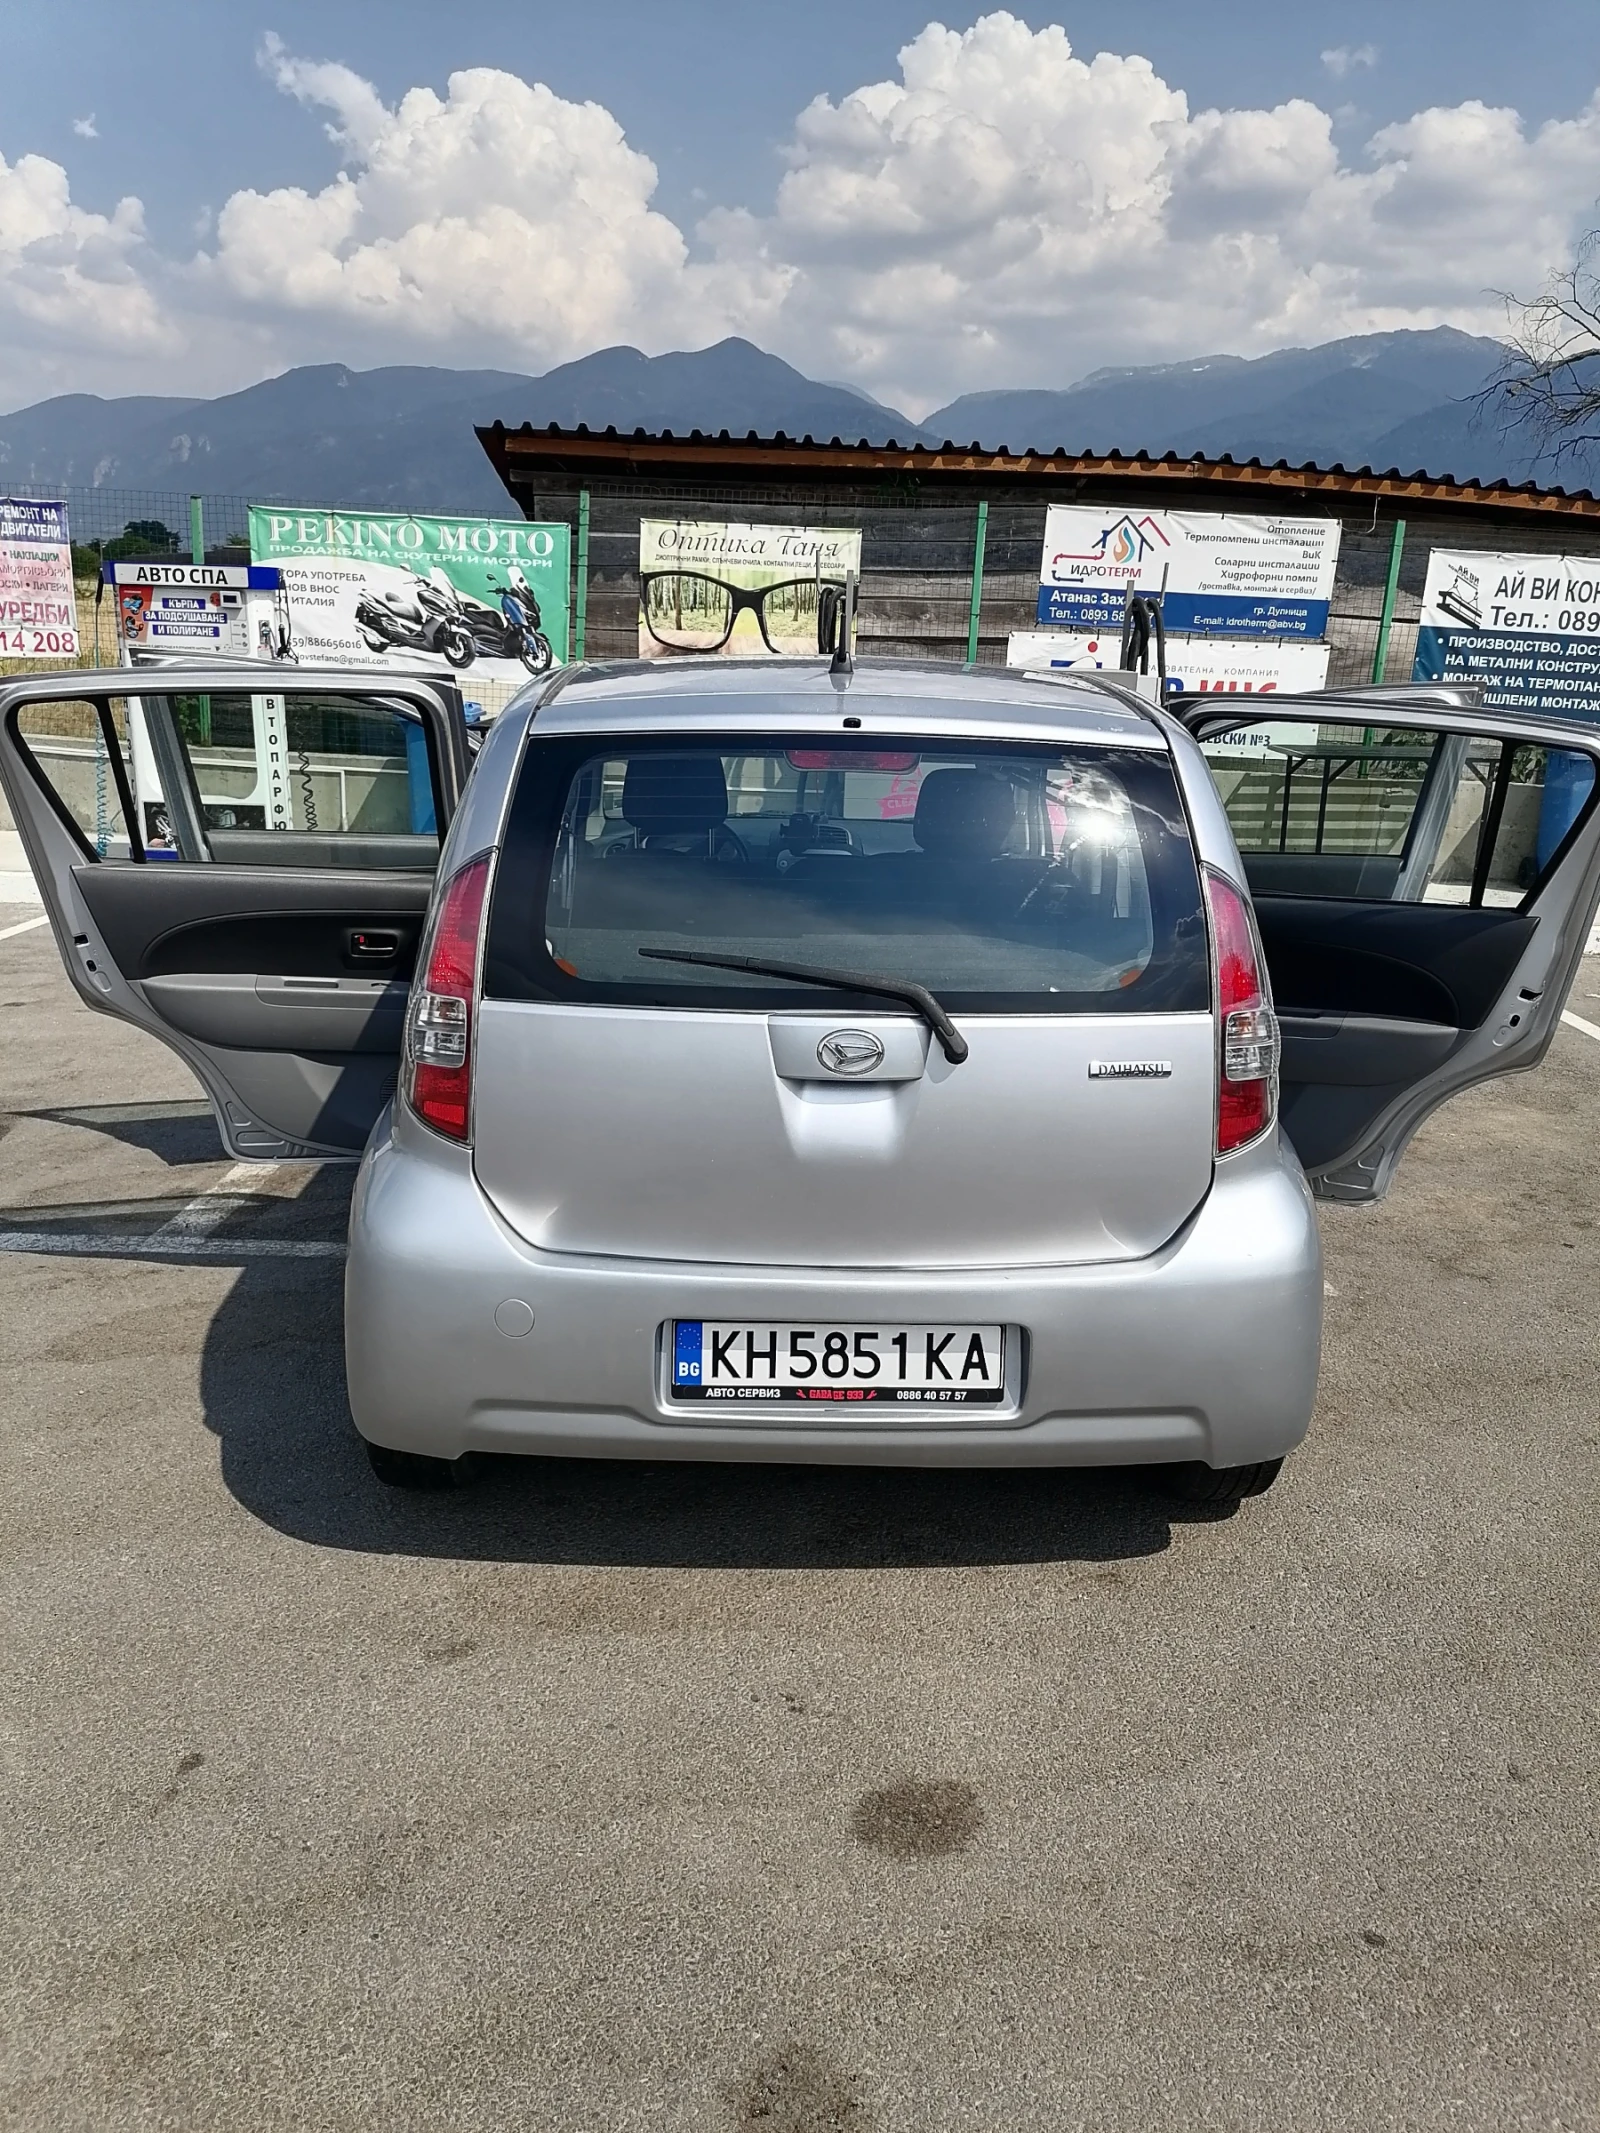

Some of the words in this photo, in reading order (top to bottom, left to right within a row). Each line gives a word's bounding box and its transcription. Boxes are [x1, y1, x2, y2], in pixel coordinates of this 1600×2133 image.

[42, 508, 58, 521] НА
[1, 522, 61, 538] ДВИГАТЕЛИ
[269, 515, 425, 549] PEKINO
[437, 525, 554, 556] MOTO
[1267, 524, 1326, 536] Отопление
[658, 529, 767, 554] Оптика
[777, 535, 844, 557] Таня
[1184, 531, 1260, 545] Термопомпени
[1262, 538, 1324, 547] инсталации
[10, 550, 60, 562] НАКЛАДКИ
[269, 544, 364, 556] ПРОДАЖБА
[367, 549, 390, 558] НА
[394, 551, 464, 563] СКУТЕРИ
[467, 556, 480, 564] И
[483, 556, 553, 568] МОТОРИ
[1302, 550, 1321, 560] ВиК
[1214, 556, 1256, 568] Соларни
[1258, 561, 1320, 570] инсталации
[137, 567, 185, 582] АВТО
[189, 569, 228, 584] СПА
[310, 571, 366, 582] УПОТРЕБА
[1070, 564, 1141, 578] ИДРОТЕРМ
[1221, 569, 1283, 582] Хидрофорни
[1285, 574, 1318, 583] помпи
[33, 581, 68, 592] ЛАГЕРИ
[310, 584, 340, 594] ВНОС
[1244, 585, 1278, 593] монтаж
[1494, 570, 1525, 598] АЙ
[1530, 578, 1560, 600] ВИ
[168, 599, 199, 609] КЪРПА
[291, 596, 335, 607] ИТАЛИЯ
[1050, 589, 1098, 605] Атанас
[145, 611, 157, 620] ЗА
[158, 612, 225, 623] ПОДСУШАВАНЕ
[1049, 607, 1077, 619] Тел.:
[1081, 608, 1108, 620] 0893
[1253, 607, 1266, 616] гр.
[1267, 606, 1307, 617] Дупница
[1193, 615, 1224, 626] E-mail:
[1226, 617, 1306, 630] idrotherm@abv.bg
[1490, 606, 1549, 629] Тел.:
[1558, 609, 1600, 632] 089
[158, 625, 166, 635] И
[167, 626, 214, 636] ПОЛИРАНЕ
[33, 631, 75, 653] 208
[1448, 635, 1564, 655] ПРОИЗВОДСТВО,
[1445, 654, 1465, 666] НА
[1468, 656, 1533, 670] МЕТАЛНИ
[1536, 659, 1600, 675] КОНСТРУ
[1224, 669, 1279, 677] КОМПАНИЯ
[1504, 676, 1524, 688] НА
[1482, 692, 1538, 707] ИШЛЕНИ
[1540, 696, 1600, 711] МОНТАЖ
[1098, 1063, 1164, 1077] DAIHATSU
[678, 1361, 700, 1377] BG
[706, 1388, 735, 1398] АВТО
[737, 1388, 780, 1398] СЕРВИЗ
[897, 1390, 922, 1400] 0886
[924, 1391, 937, 1400] 40
[939, 1391, 952, 1400] 57
[954, 1391, 967, 1401] 57
